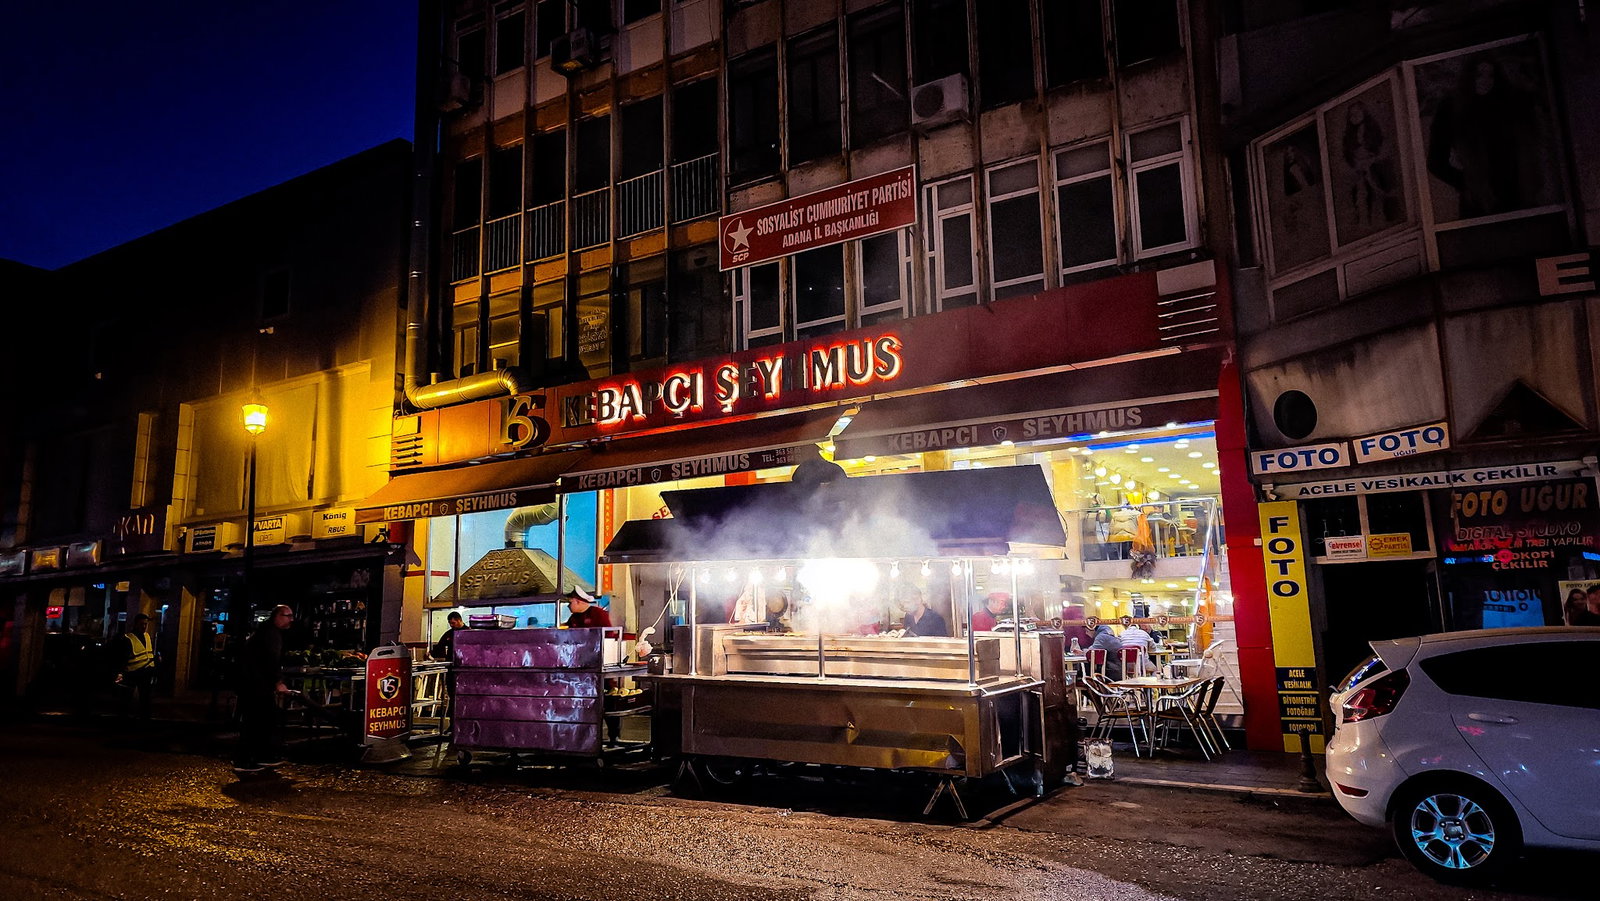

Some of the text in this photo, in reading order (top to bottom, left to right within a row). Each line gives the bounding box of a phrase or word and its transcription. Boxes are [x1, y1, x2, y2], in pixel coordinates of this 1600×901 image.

[756, 172, 912, 237] SOSYALİST CUMHURİYET PARTİSİ
[782, 209, 880, 249] ADANA İL BAŞKANLIĞI
[732, 251, 750, 264] SCP
[1535, 252, 1596, 297] E
[560, 335, 903, 429] KEBAPÇI ŞEYHMUS
[1260, 448, 1341, 472] FOTO
[1298, 464, 1558, 497] ACELE VESİKALIK ÇEKİLİR
[257, 518, 282, 531] VARTA
[1268, 517, 1300, 597] FOTO
